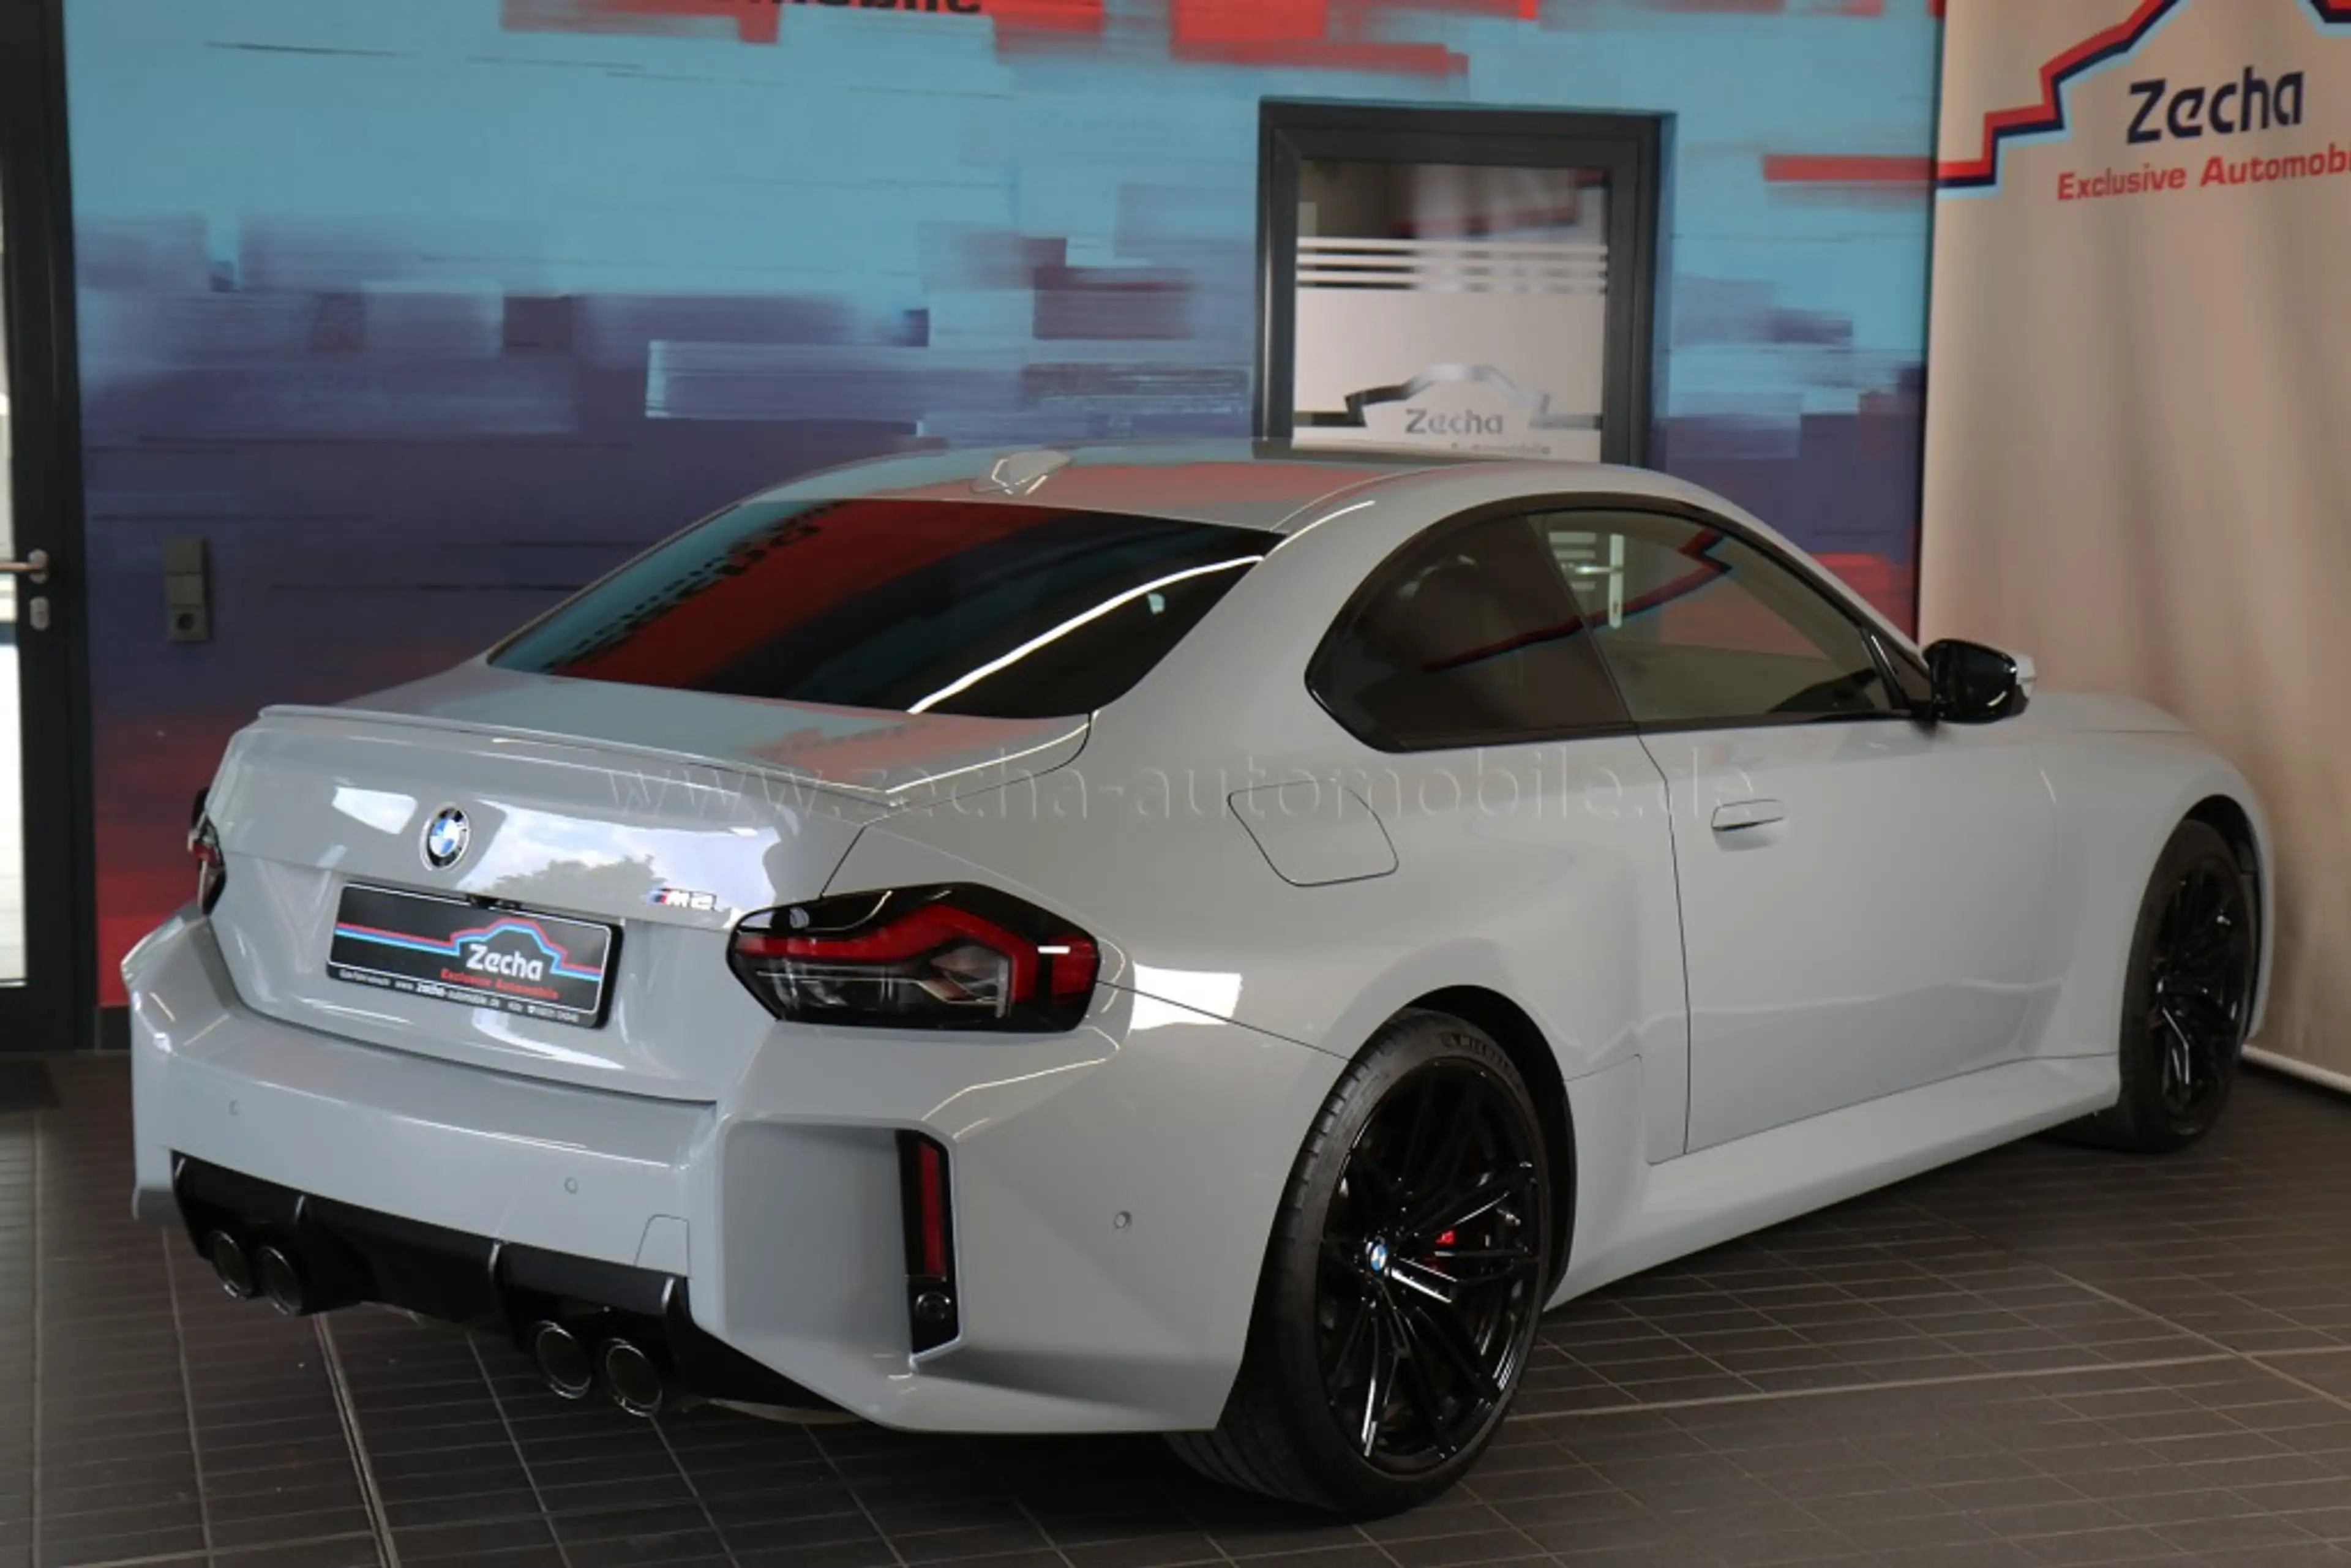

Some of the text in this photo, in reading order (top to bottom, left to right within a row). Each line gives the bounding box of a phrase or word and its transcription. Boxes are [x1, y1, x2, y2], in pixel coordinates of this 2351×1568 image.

[2128, 65, 2304, 144] Zecha
[2058, 162, 2187, 201] Exclusive
[1404, 408, 1504, 435] Zecha
[466, 943, 543, 981] Zecha
